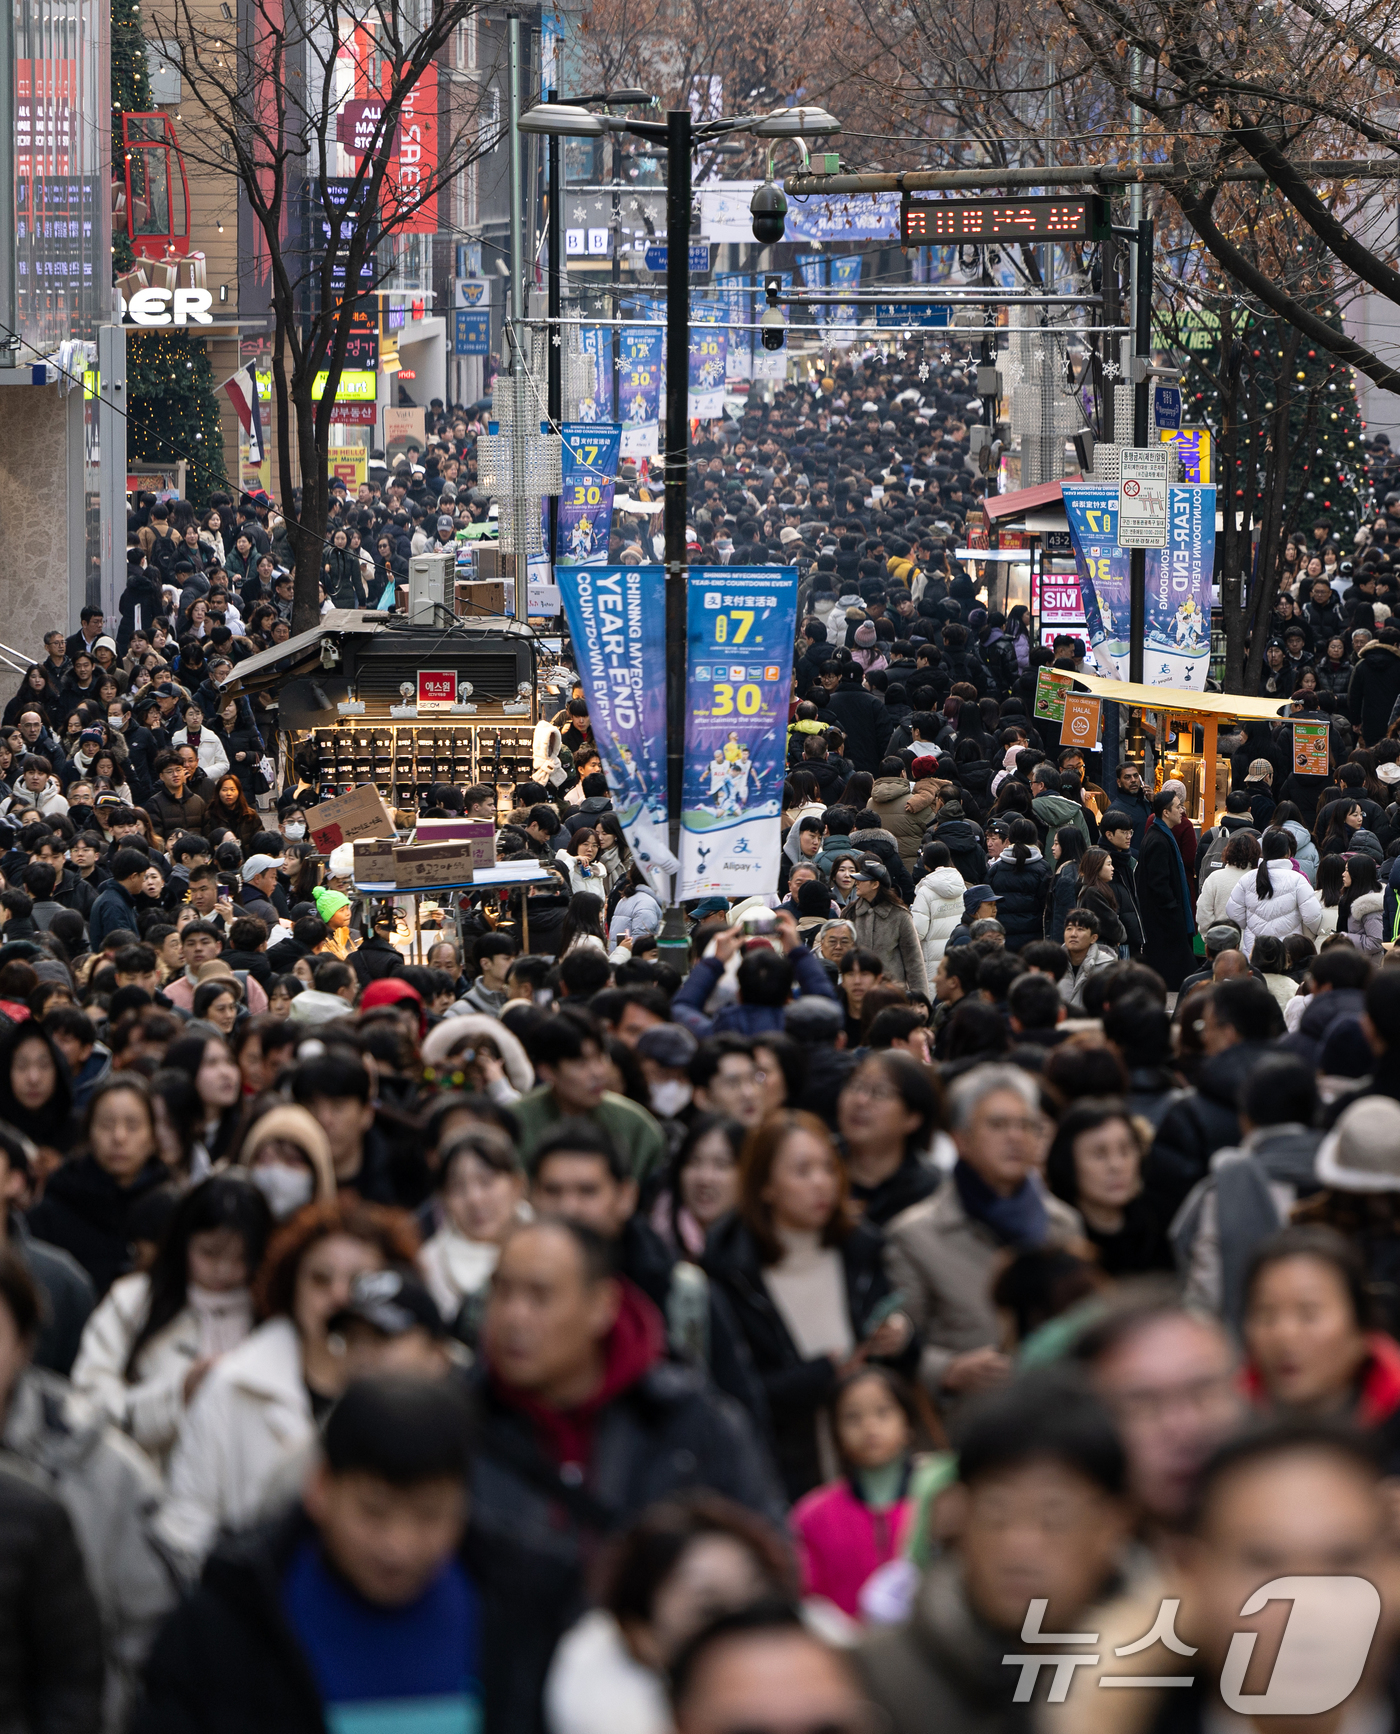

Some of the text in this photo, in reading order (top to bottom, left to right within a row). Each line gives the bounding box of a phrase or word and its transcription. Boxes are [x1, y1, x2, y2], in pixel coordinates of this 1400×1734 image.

[356, 122, 386, 134] MA
[354, 137, 384, 148] STOR
[122, 287, 213, 325] ER
[1187, 310, 1249, 328] CHRISAS
[700, 343, 718, 354] 30
[348, 381, 367, 392] art
[631, 373, 650, 386] 30
[585, 446, 598, 465] 7
[573, 487, 600, 505] 30
[1049, 536, 1070, 545] 43-2
[626, 573, 642, 638] SHINING
[723, 596, 777, 607] 支付宝活动
[1044, 592, 1076, 608] SIM
[577, 573, 606, 676] COUNTDOWN
[730, 610, 755, 644] 7
[596, 573, 636, 730] YEAR-END
[425, 682, 450, 692] 에스원
[712, 684, 761, 716] 30
[733, 837, 752, 854] 支
[723, 862, 751, 871] Alipay
